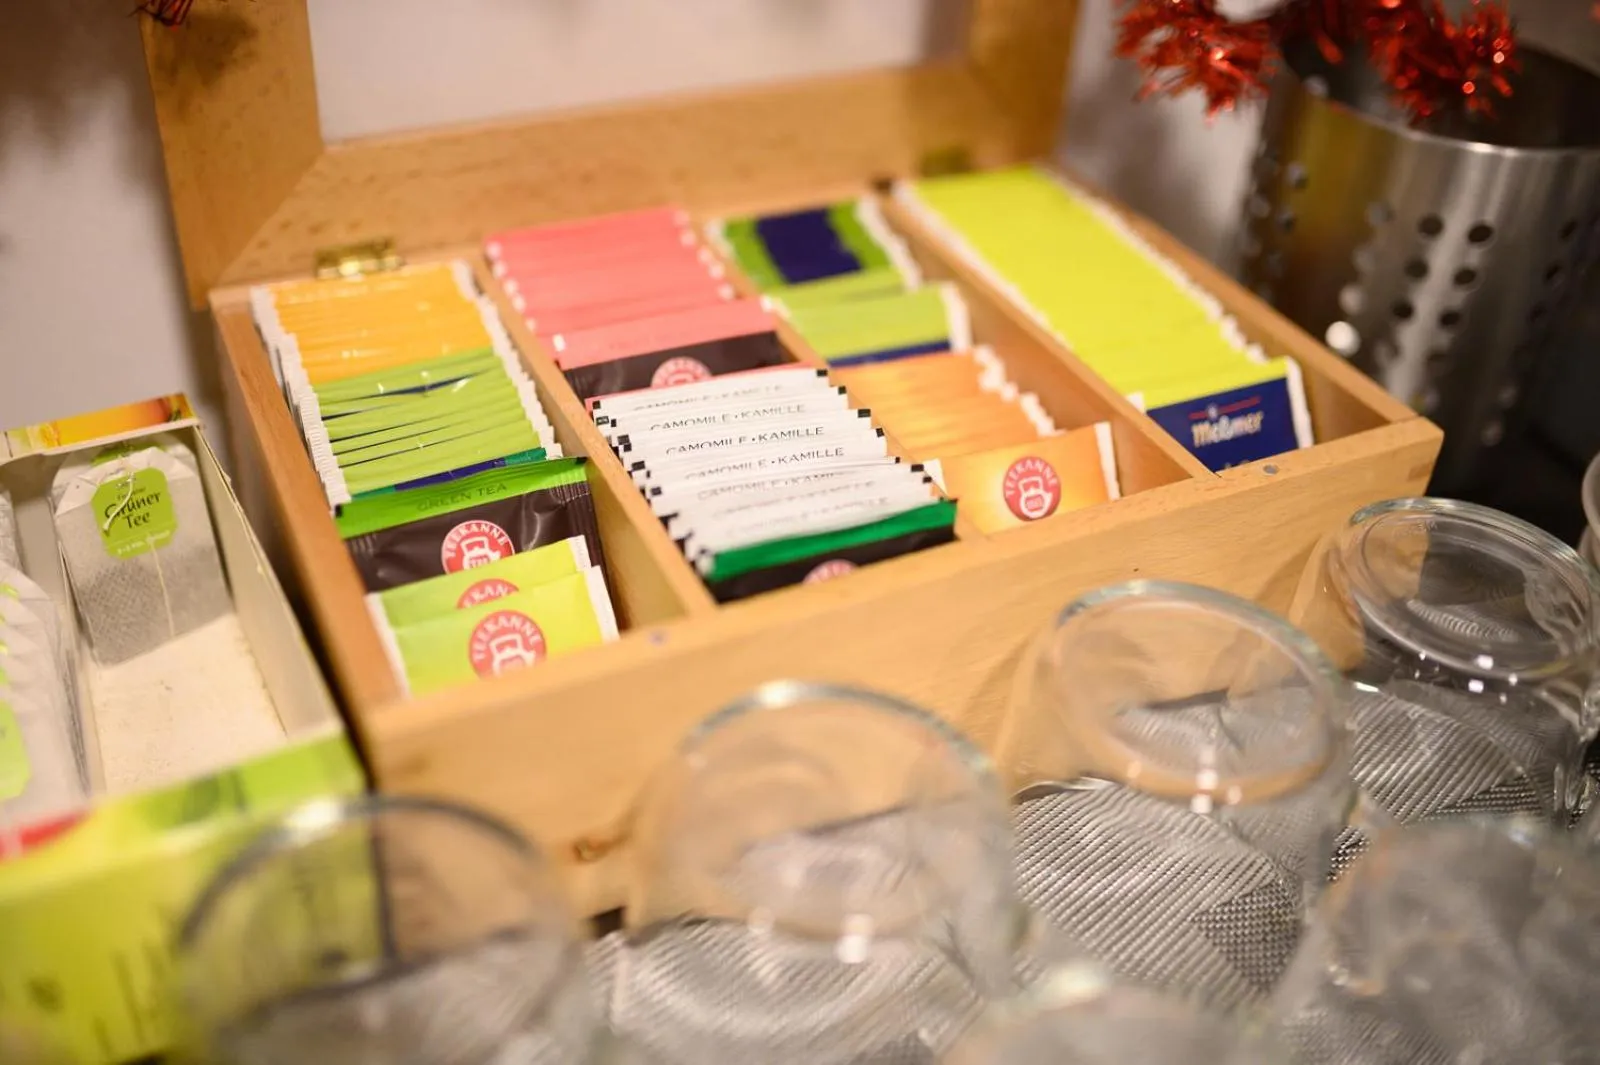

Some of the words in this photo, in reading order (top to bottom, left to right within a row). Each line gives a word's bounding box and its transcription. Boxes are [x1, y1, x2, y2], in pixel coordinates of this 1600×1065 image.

[740, 404, 806, 421] KAMILLE
[757, 426, 825, 443] KAMILLE
[778, 446, 845, 465] KAMILLE
[1005, 458, 1059, 498] TEEKANNE
[416, 491, 472, 512] GREEN
[475, 481, 508, 498] TEA
[121, 511, 151, 529] Tee
[445, 522, 509, 558] TEEKANNE
[471, 614, 543, 662] TEEKANNE
